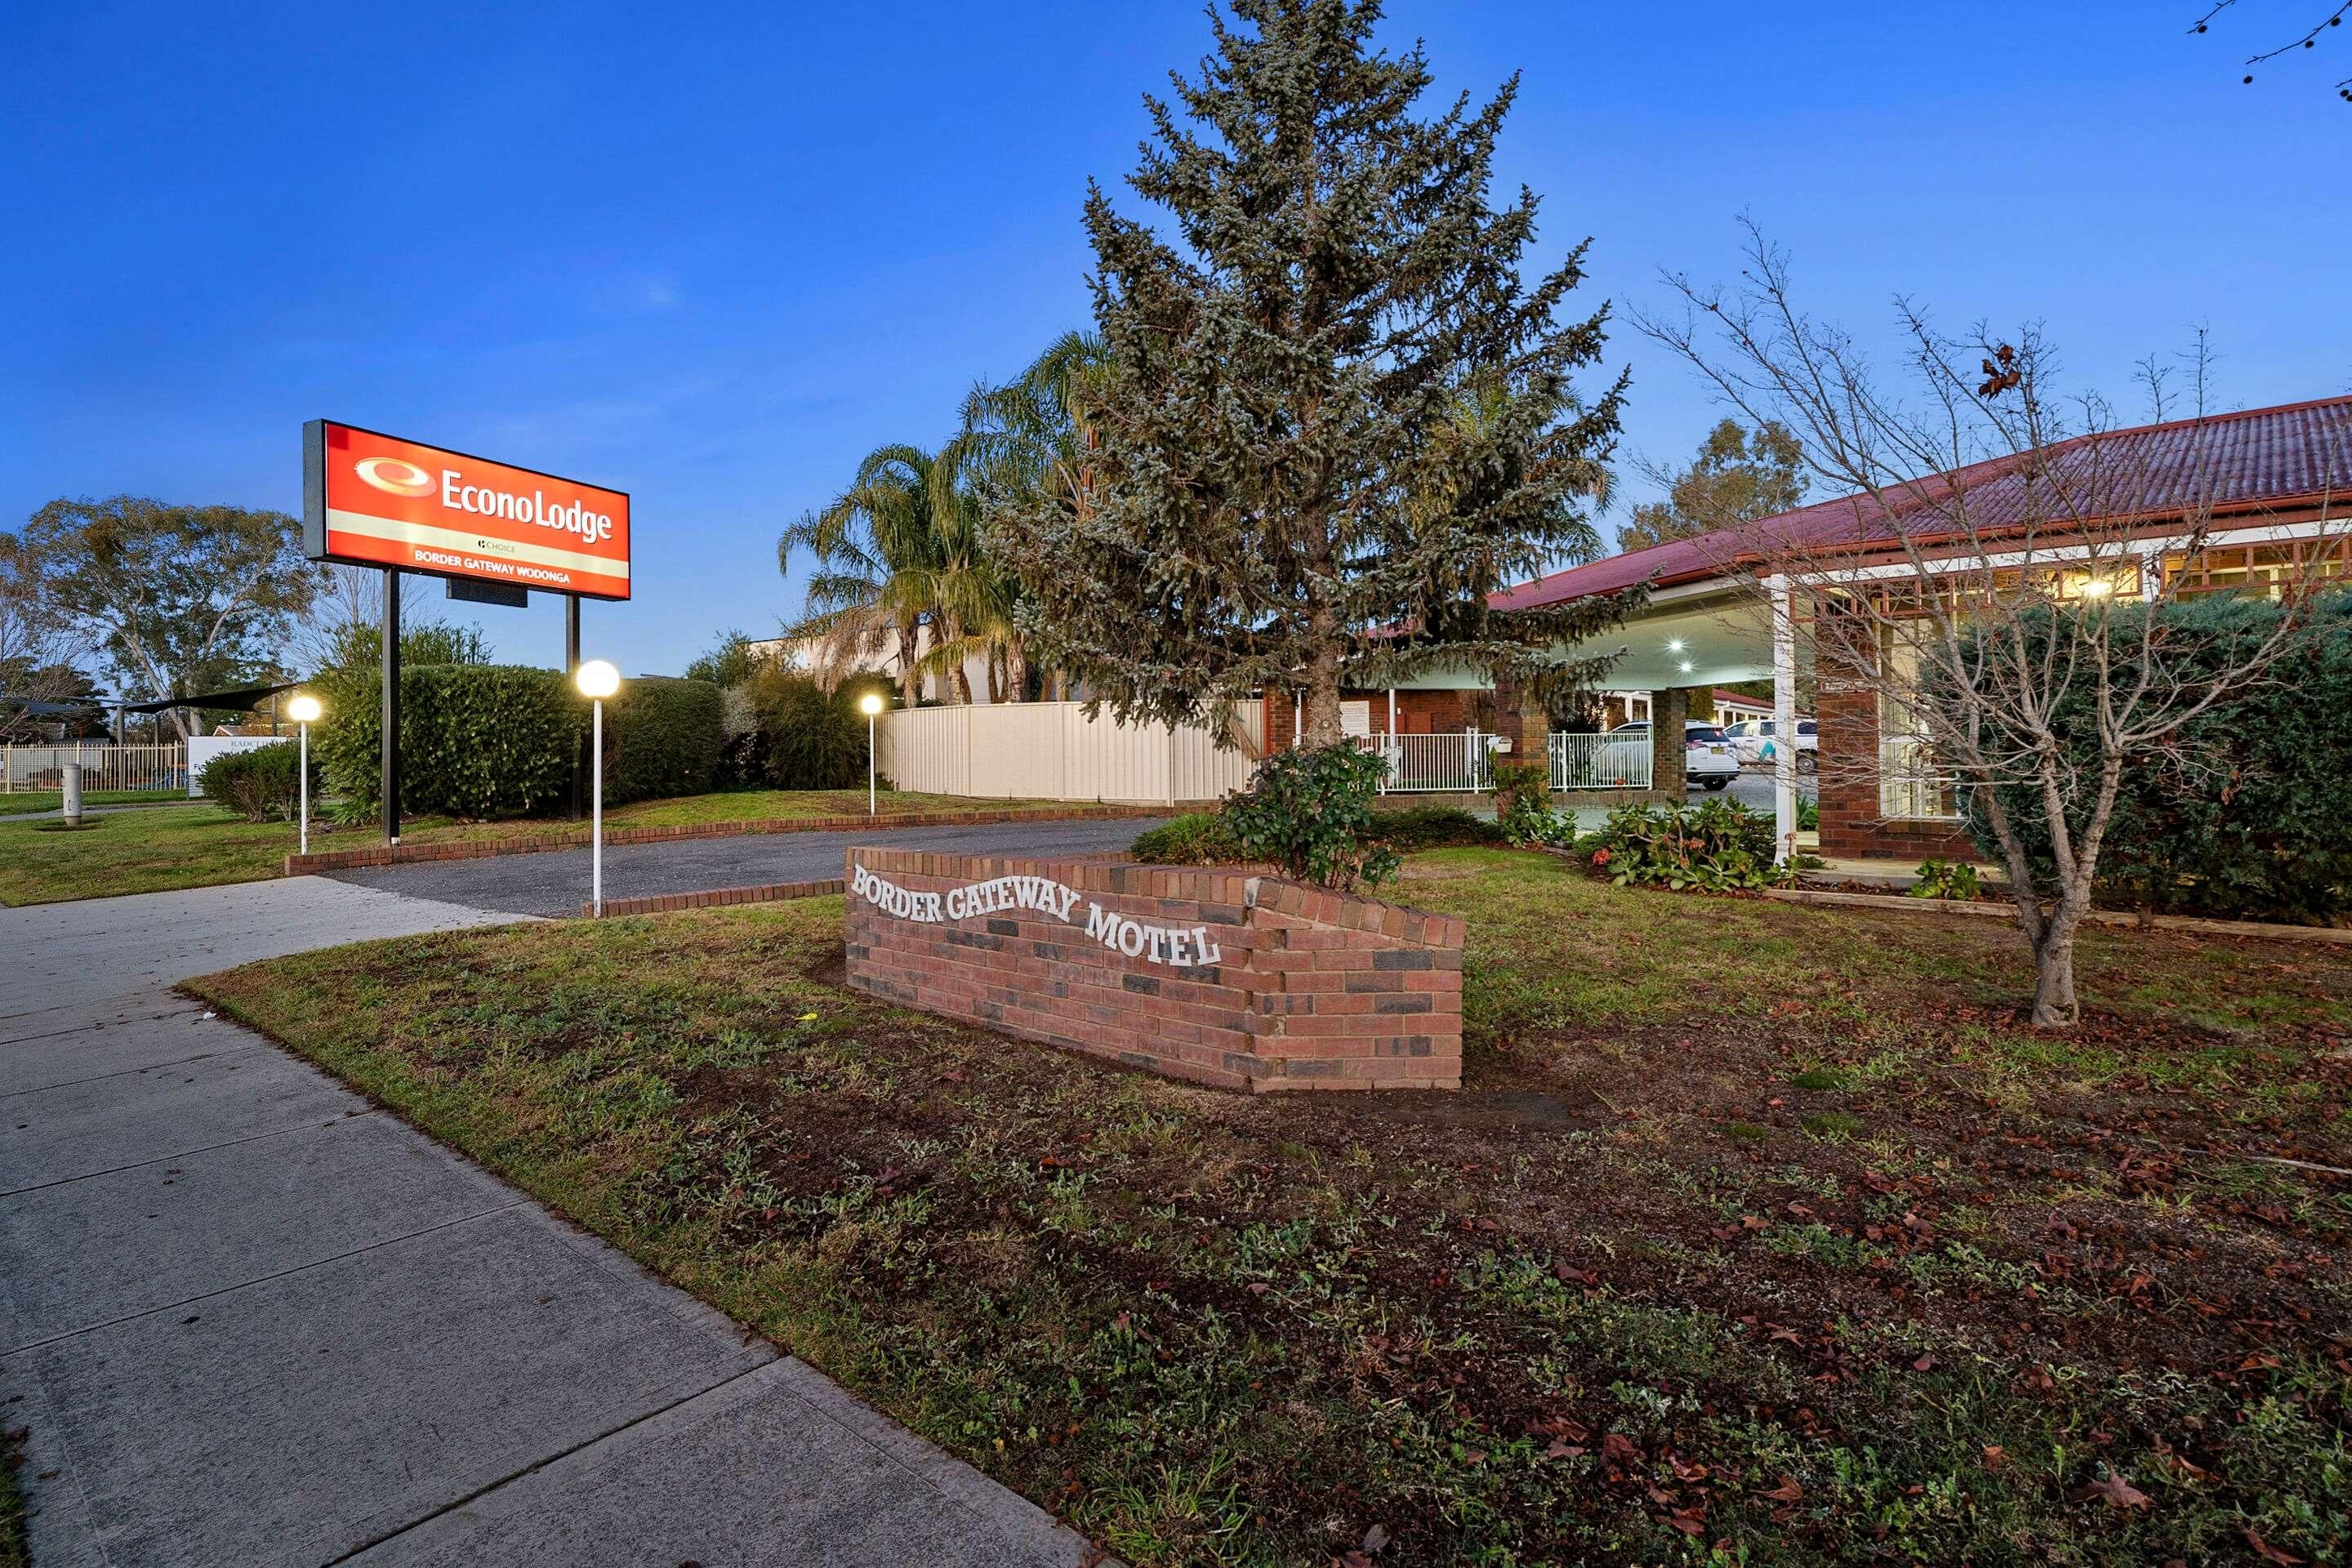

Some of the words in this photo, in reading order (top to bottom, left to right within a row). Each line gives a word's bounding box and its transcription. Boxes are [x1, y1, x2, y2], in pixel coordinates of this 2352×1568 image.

[442, 470, 612, 544] EconoLodge
[415, 550, 461, 567] BORDER
[464, 558, 515, 576] GATEWAY
[516, 567, 571, 583] WODONGA
[486, 541, 516, 554] CHOICE
[851, 863, 944, 922] BORDER
[947, 875, 1080, 923] GATEWAY
[1085, 902, 1221, 966] MOTEL
